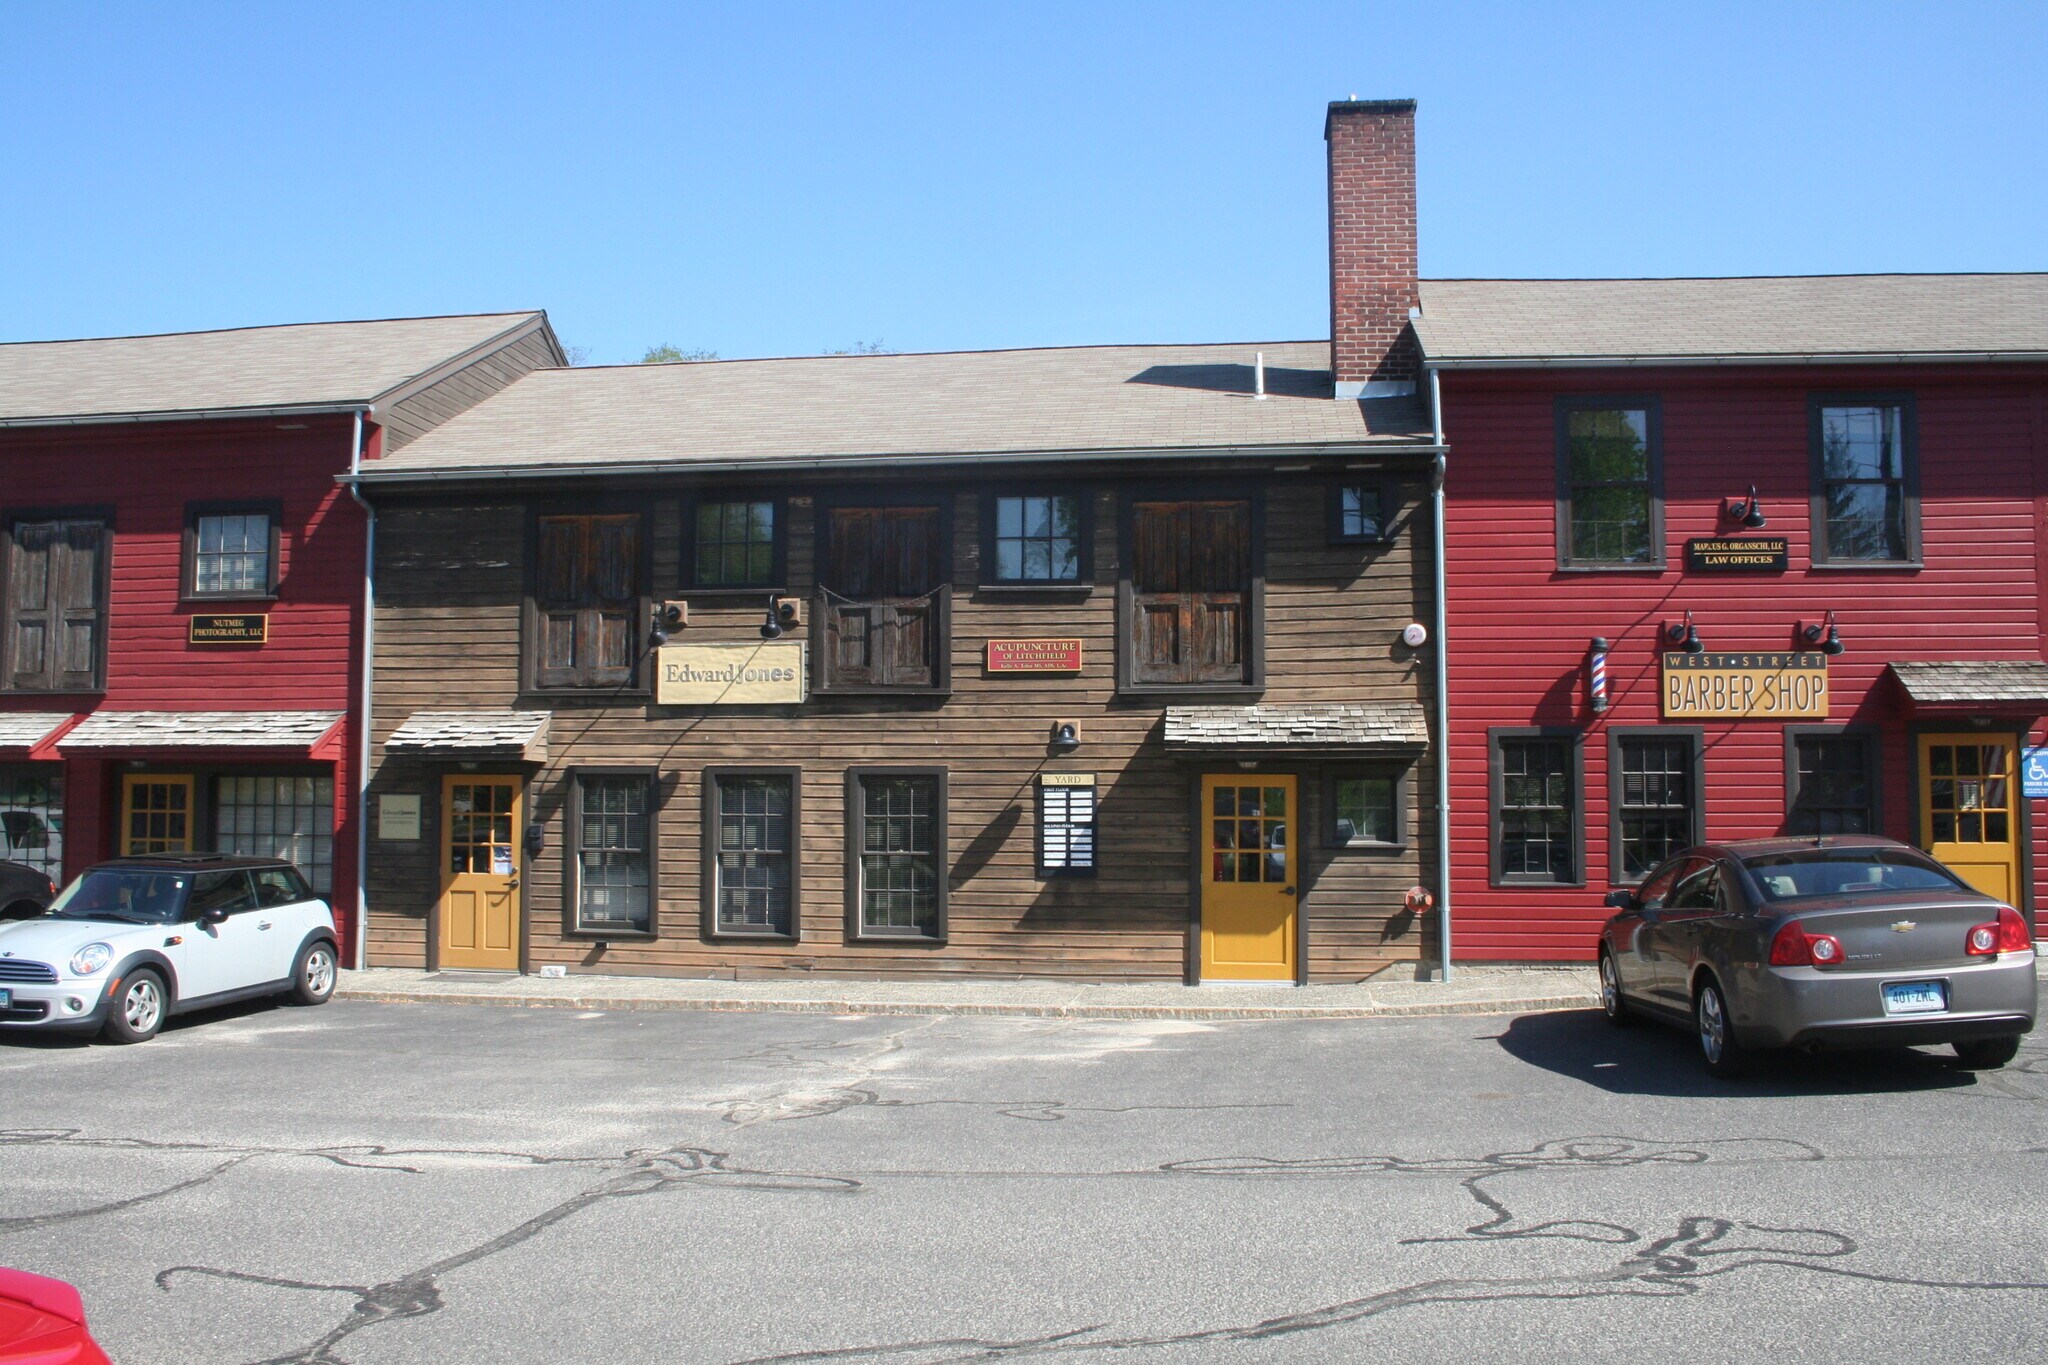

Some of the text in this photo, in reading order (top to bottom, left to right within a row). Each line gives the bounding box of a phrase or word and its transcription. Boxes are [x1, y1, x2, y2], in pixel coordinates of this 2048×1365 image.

[1721, 542, 1729, 550] G.
[1729, 542, 1770, 551] ORGANSCHI,
[1770, 541, 1784, 550] LLC
[1705, 555, 1773, 564] LAW OFFICES
[213, 619, 245, 627] NUTMEG
[194, 628, 263, 636] PHOTOGRAPHY, LLC
[993, 642, 1076, 651] ACUPUNCTURE
[1003, 652, 1067, 660] OF LITCHFIELD
[1669, 656, 1822, 667] WEST STREET
[1669, 674, 1825, 712] BARBER SHOP
[1055, 775, 1082, 784] YARD
